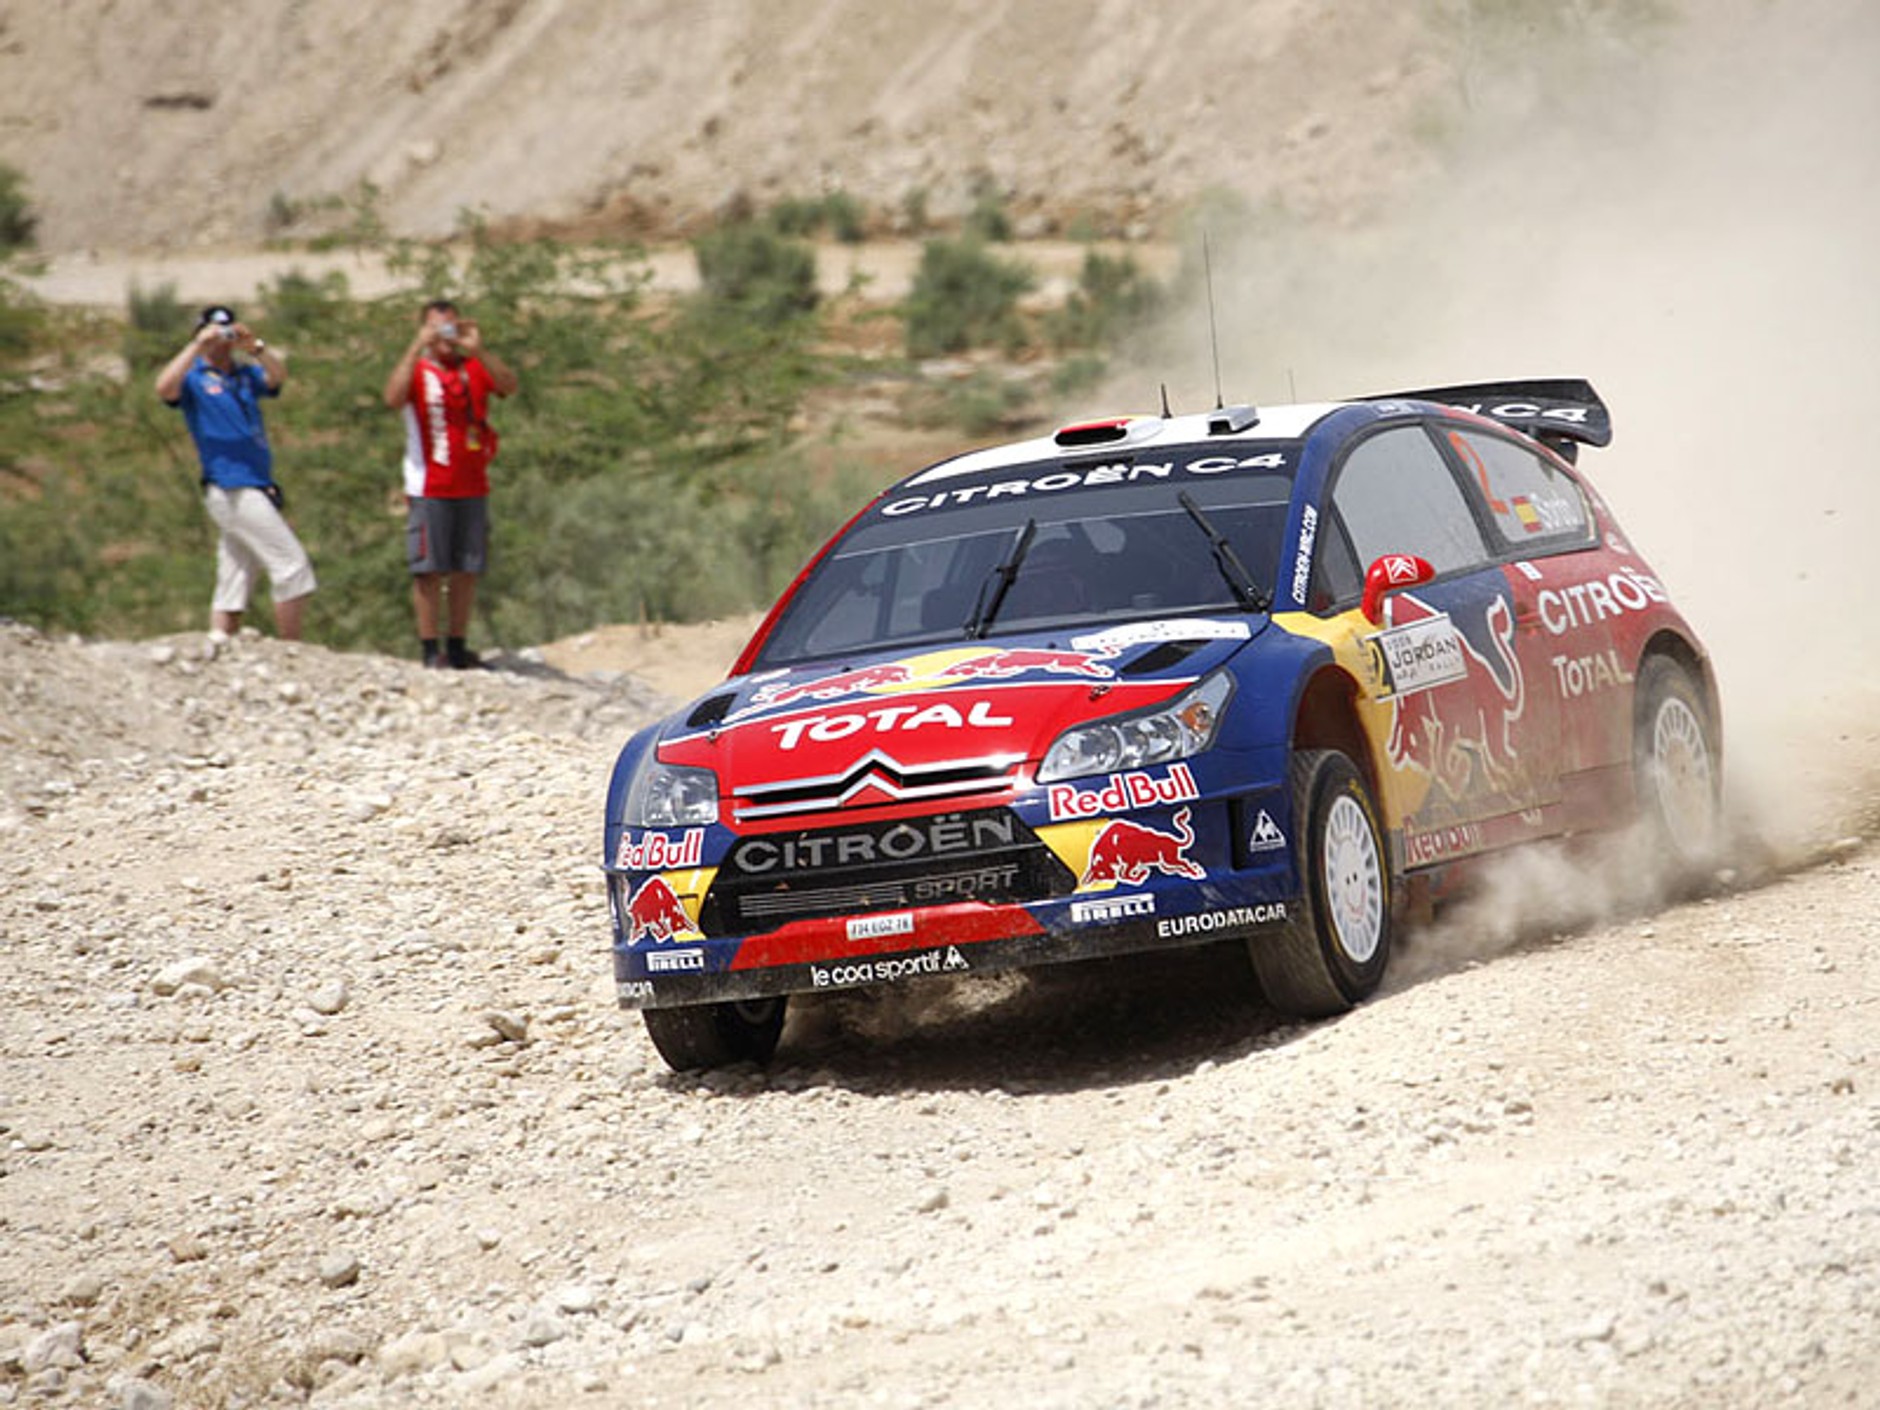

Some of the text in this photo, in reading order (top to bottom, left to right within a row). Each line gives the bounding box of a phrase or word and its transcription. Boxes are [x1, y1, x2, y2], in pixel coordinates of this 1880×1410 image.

[1491, 403, 1588, 422] C4
[1186, 452, 1287, 474] C4
[1537, 566, 1669, 636] CITROË
[1392, 638, 1457, 669] JORDAN
[1552, 650, 1633, 699] TOTAL
[770, 702, 1014, 750] TOTAL
[1050, 763, 1199, 821] Red Bull
[649, 828, 704, 867] Bull
[734, 813, 1014, 873] CITROËN
[914, 866, 1019, 899] SPORT
[1070, 893, 1155, 923] PIRELLI
[1157, 903, 1287, 937] EURODATACAR
[811, 966, 830, 986] le
[874, 950, 941, 981] sportif
